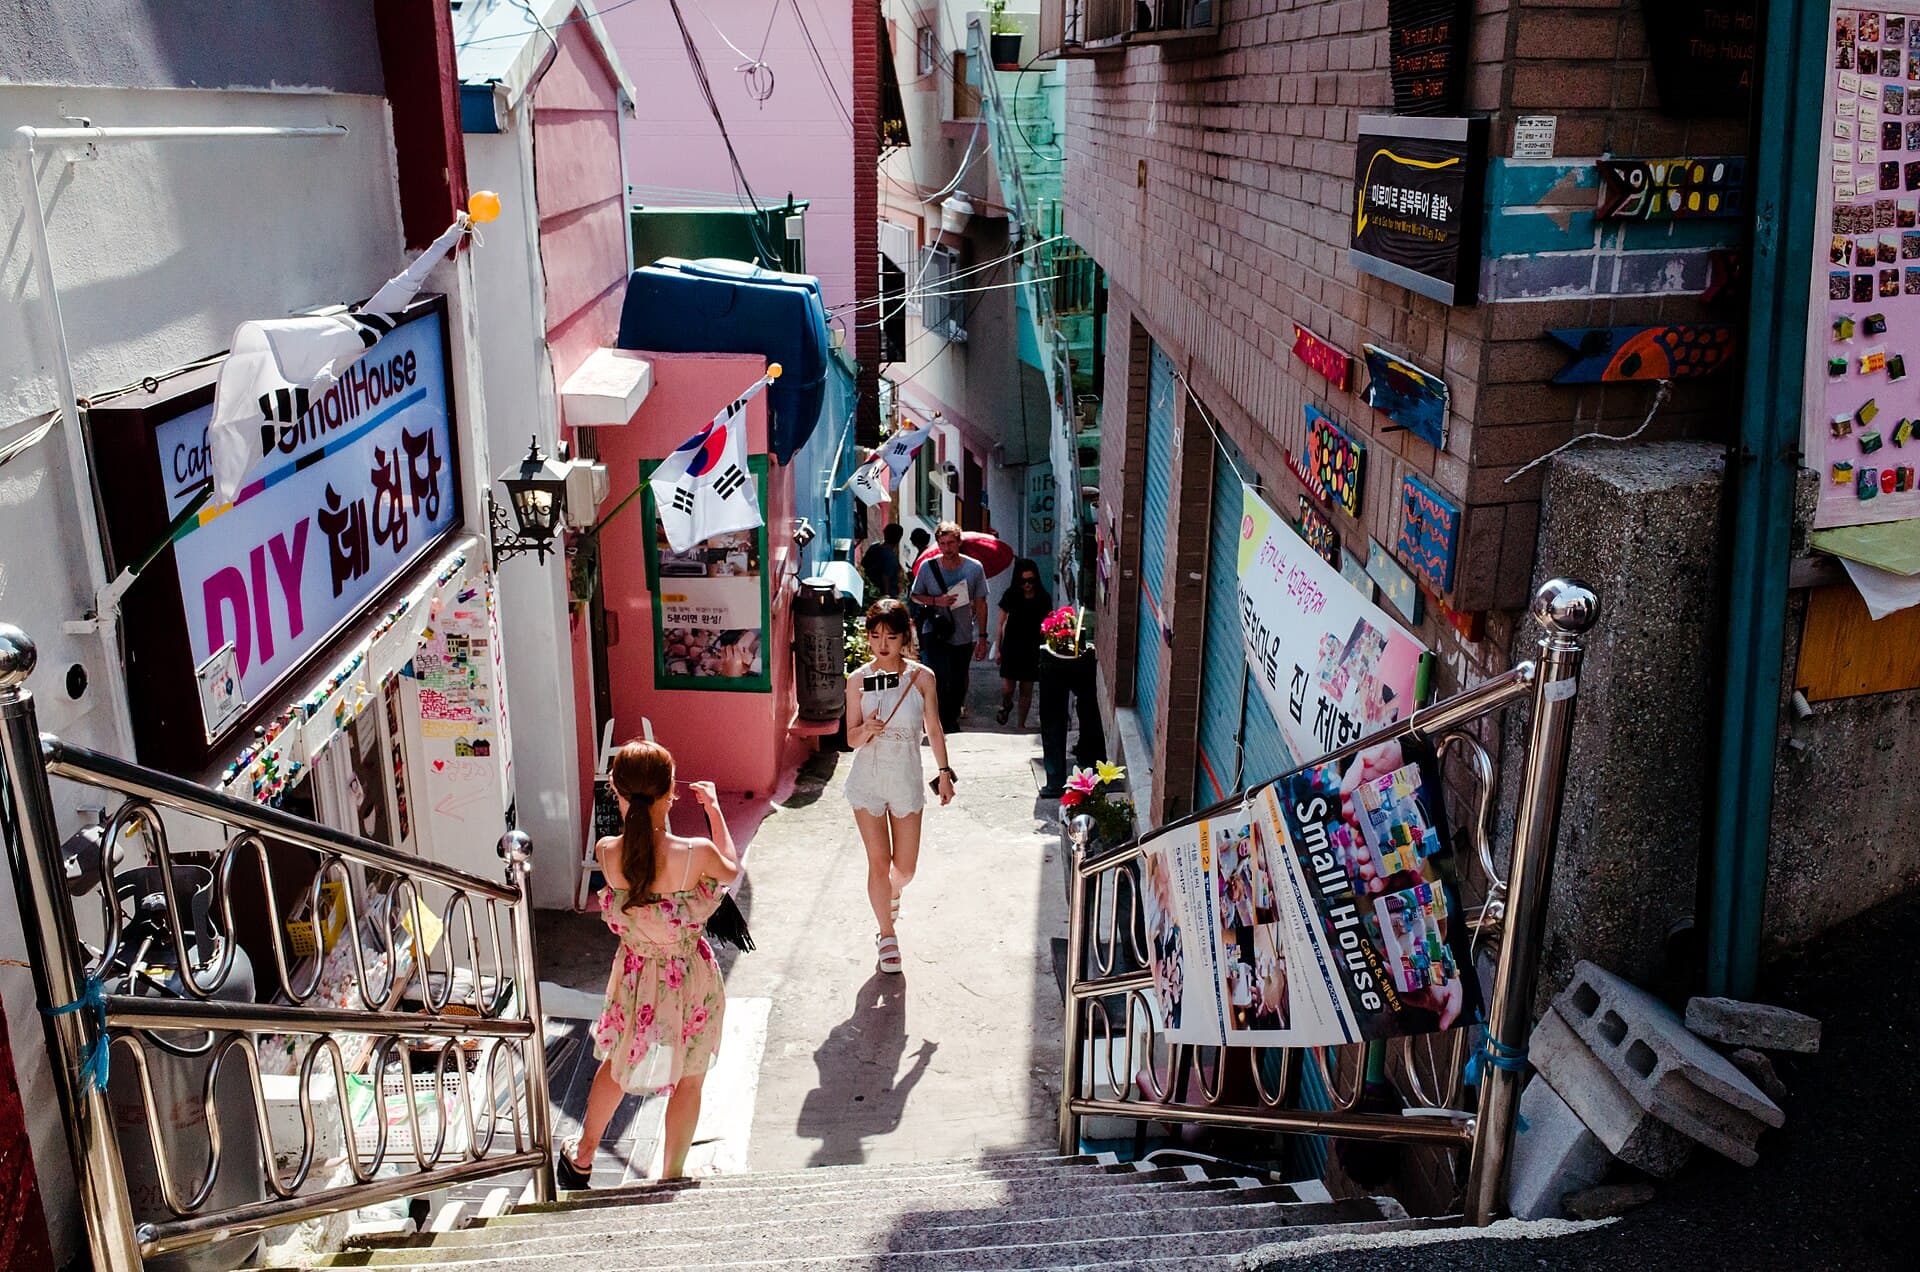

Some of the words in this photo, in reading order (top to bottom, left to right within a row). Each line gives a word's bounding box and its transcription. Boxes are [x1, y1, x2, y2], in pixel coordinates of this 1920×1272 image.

[1703, 8, 1729, 31] The
[1734, 12, 1755, 32] Ho
[1689, 38, 1714, 58] The
[1720, 39, 1754, 60] Hous
[1371, 183, 1399, 209] 미로미로
[1400, 188, 1430, 218] 골목투어
[173, 424, 213, 484] Caf
[203, 516, 310, 680] DIY
[1260, 535, 1287, 583] 향기나는
[1286, 562, 1328, 615] 석고방향제
[667, 614, 698, 624] 5분이면
[1289, 663, 1309, 726] 집
[1297, 797, 1349, 895] Small
[1330, 903, 1382, 1011] House
[1360, 938, 1377, 968] Cafe
[1374, 967, 1383, 980] &
